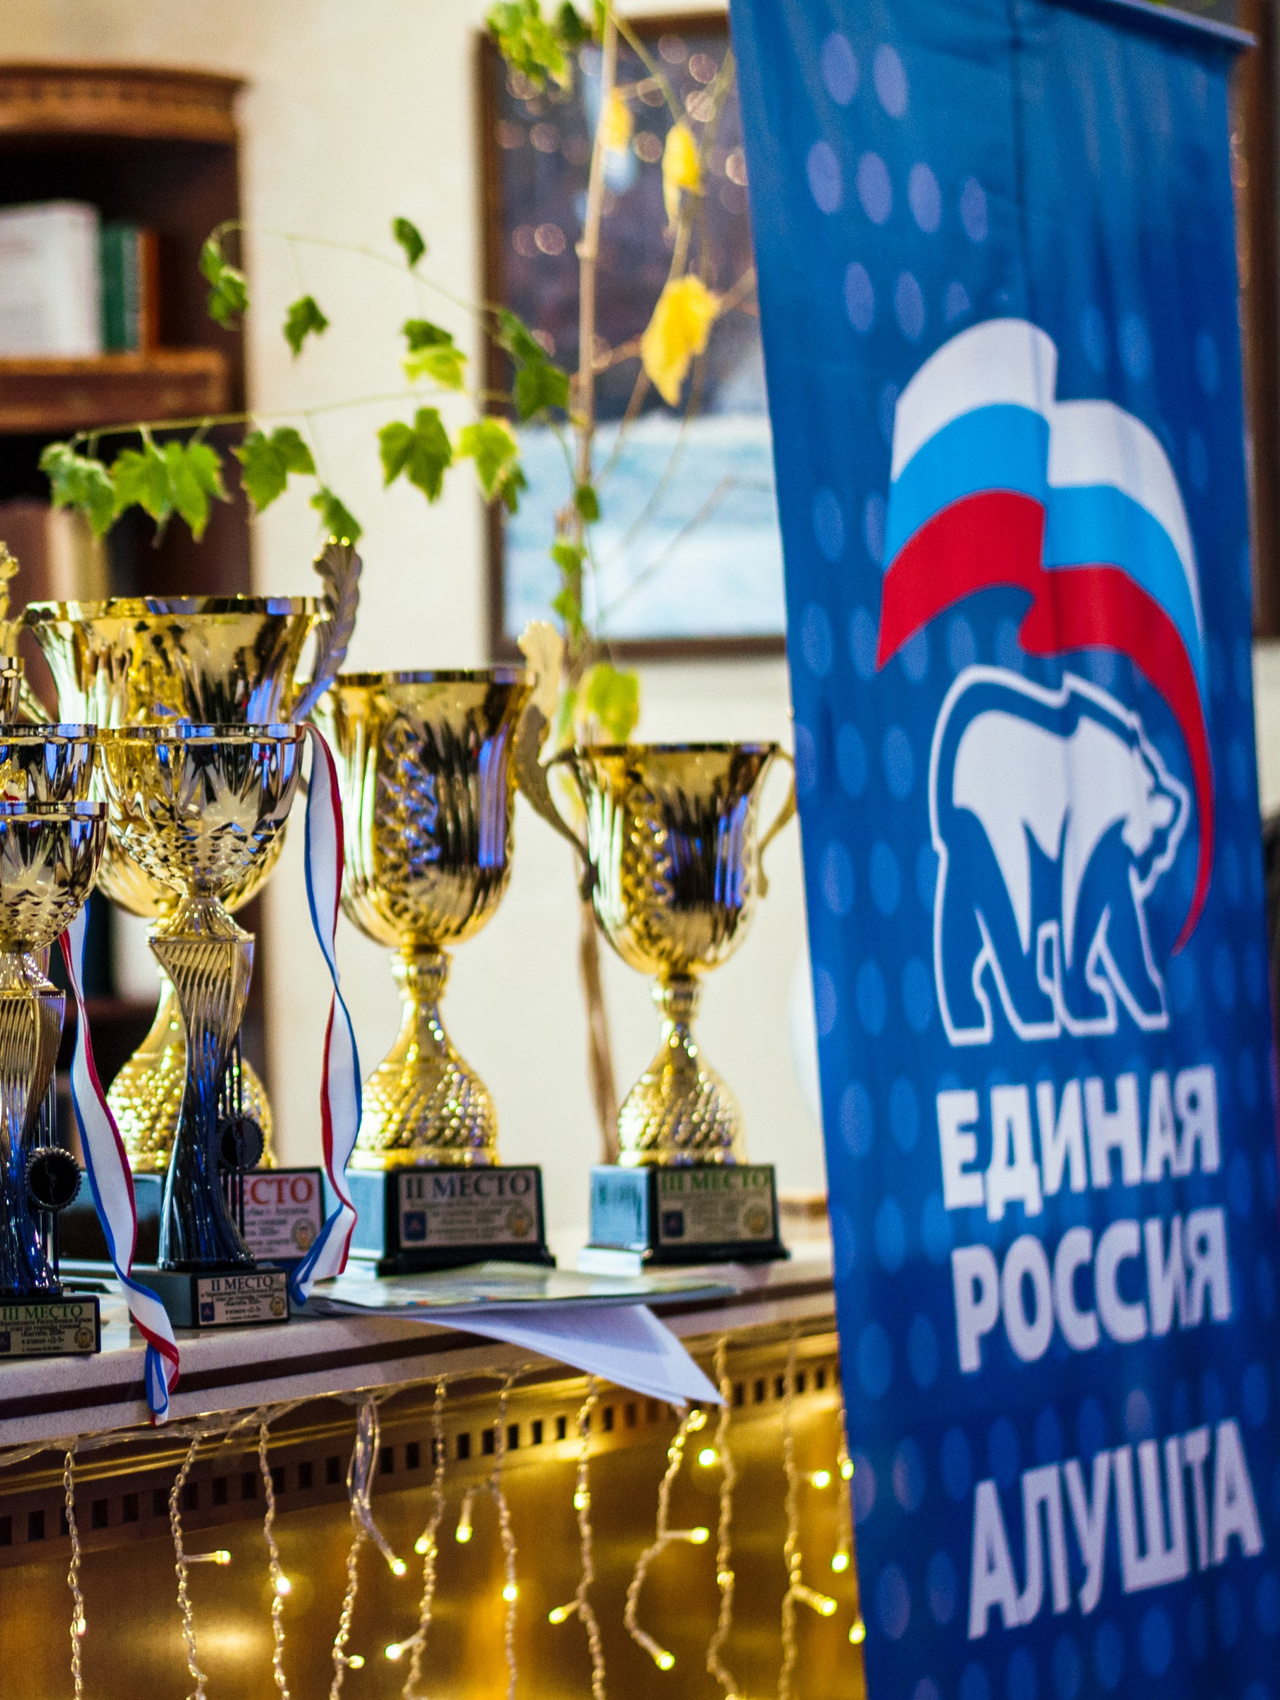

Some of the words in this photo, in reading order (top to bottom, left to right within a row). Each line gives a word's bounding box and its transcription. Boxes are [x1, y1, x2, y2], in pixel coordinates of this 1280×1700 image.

[936, 1064, 1221, 1222] ЕДИНАЯ
[241, 1177, 314, 1206] СТО
[405, 1177, 423, 1199] II
[432, 1172, 531, 1198] МЕСТО
[211, 1279, 221, 1291] II
[224, 1275, 274, 1290] МЕСТО
[951, 1206, 1231, 1374] РОССИЯ
[3, 1306, 20, 1320] III
[24, 1304, 84, 1319] МЕСТО
[967, 1416, 1263, 1639] АЛУШТА
